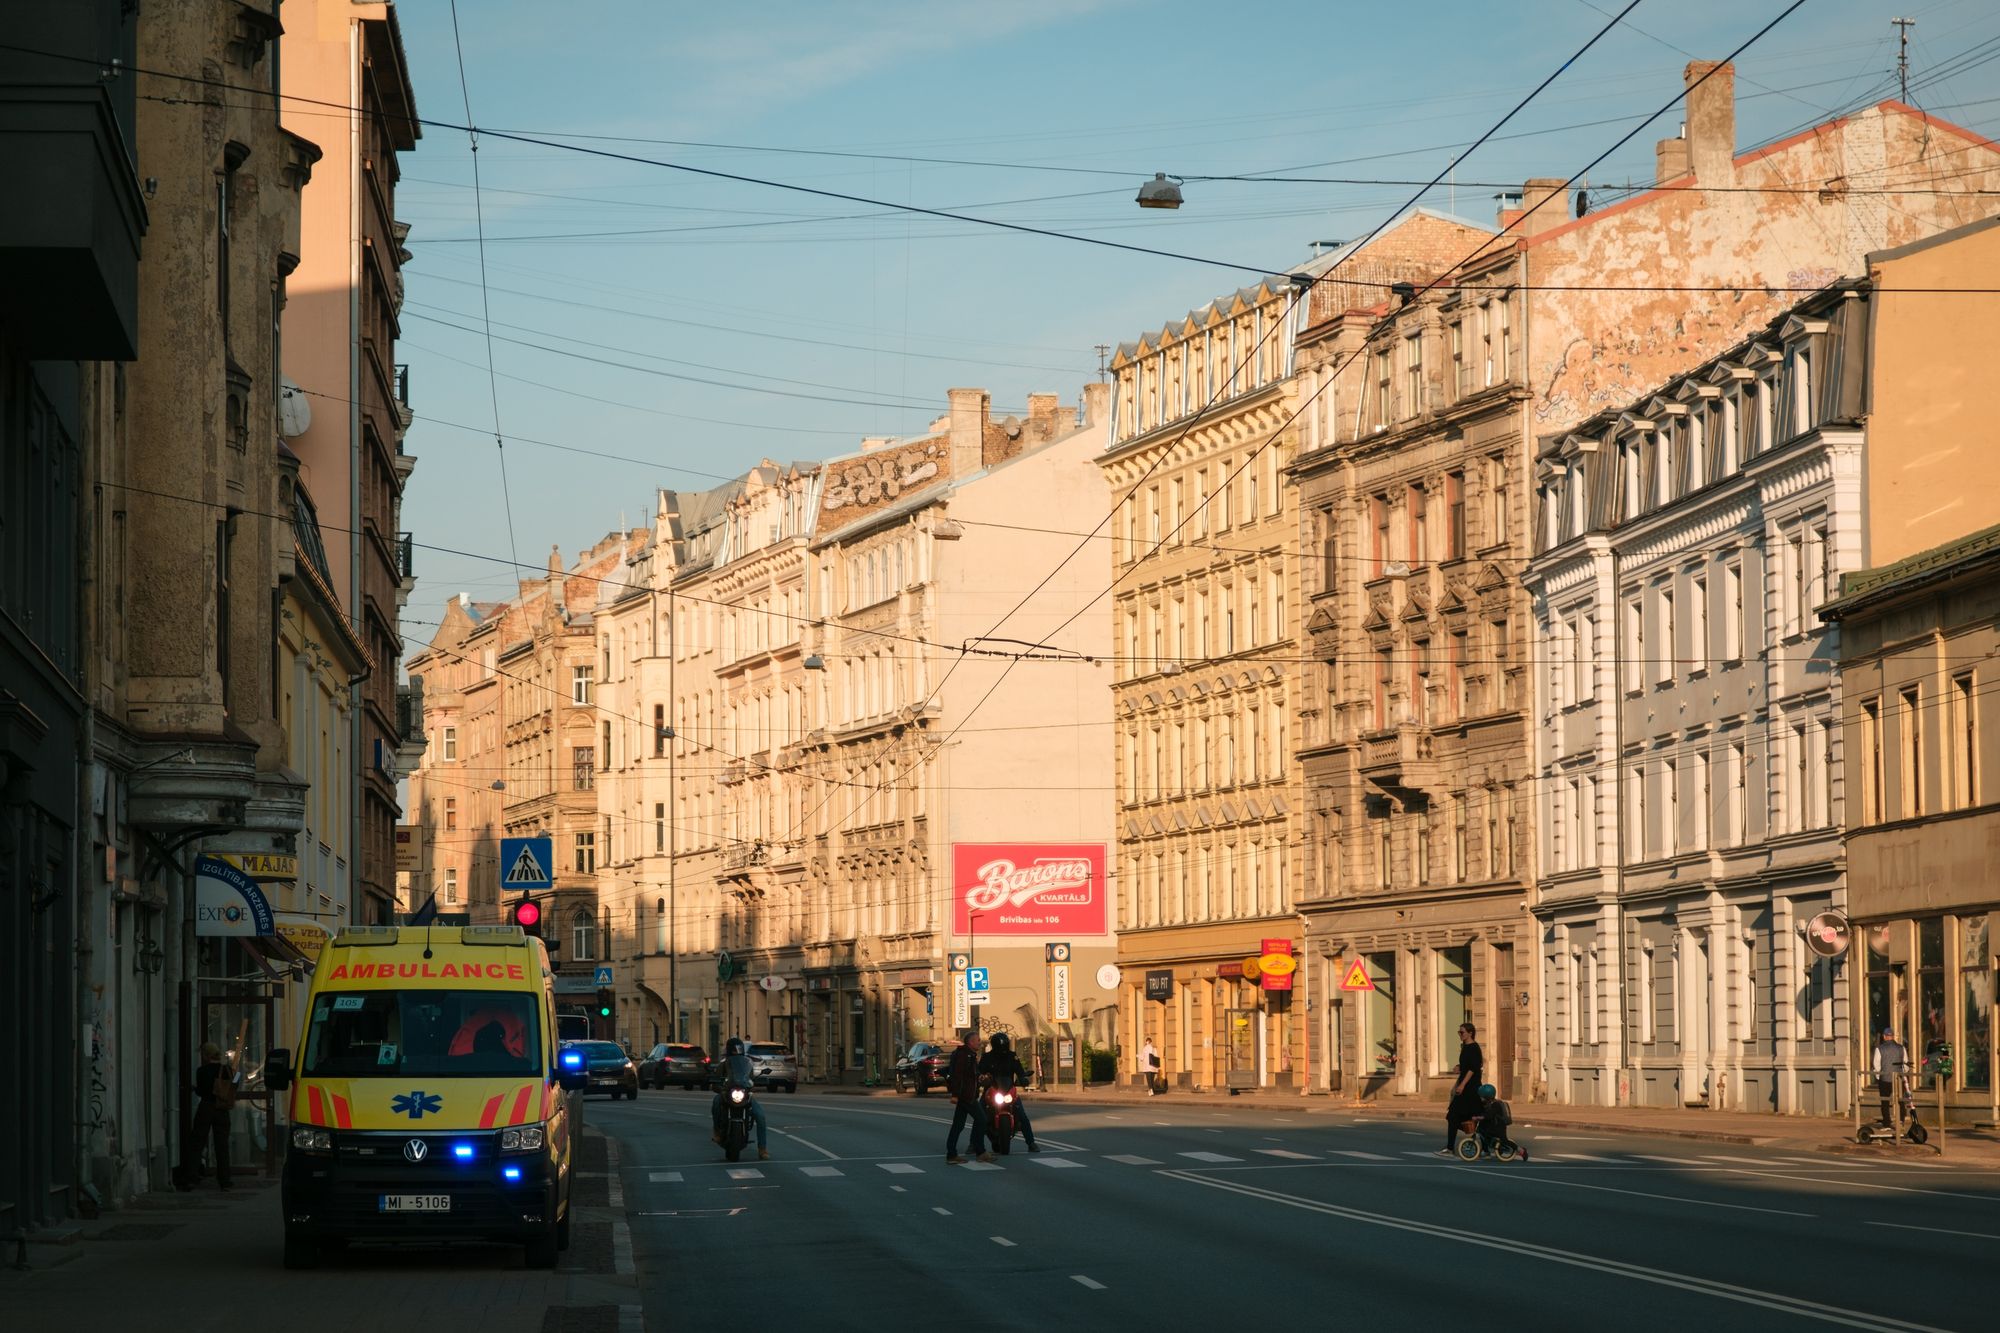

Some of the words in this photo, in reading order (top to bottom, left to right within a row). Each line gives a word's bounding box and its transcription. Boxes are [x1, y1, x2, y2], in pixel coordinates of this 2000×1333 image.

[965, 859, 1088, 911] Barons
[1040, 893, 1086, 902] KVARTĀLS
[1045, 916, 1060, 924] 106
[1058, 948, 1064, 957] P
[330, 963, 524, 980] AMBULANCE
[970, 970, 984, 989] P
[957, 987, 966, 1022] Cityparks
[1057, 980, 1067, 1017] Cityparks
